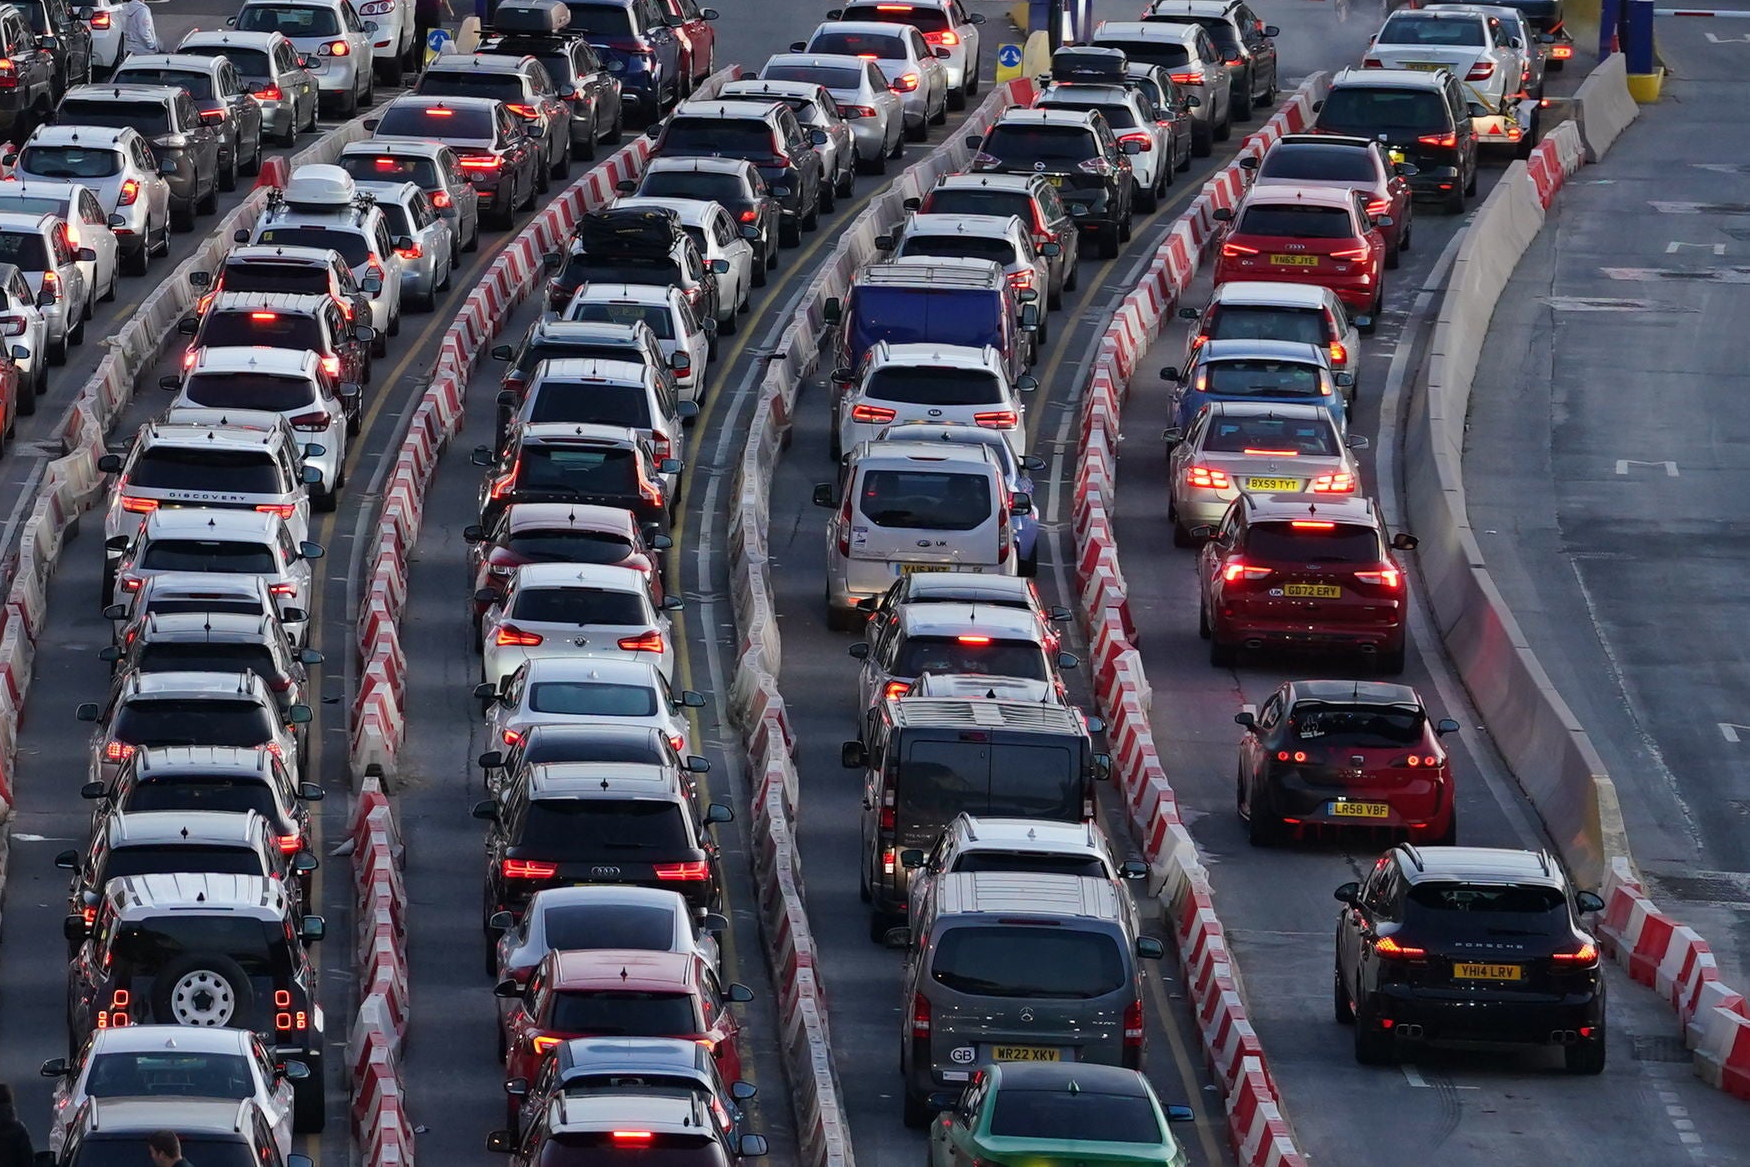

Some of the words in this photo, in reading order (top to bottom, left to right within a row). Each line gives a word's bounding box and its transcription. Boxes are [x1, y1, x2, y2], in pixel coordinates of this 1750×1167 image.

[1252, 479, 1277, 489] BX59
[1278, 480, 1296, 489] TYT
[170, 492, 246, 500] DISCOVERY
[1317, 587, 1337, 596] ERY
[1335, 802, 1363, 814] LR58
[1366, 804, 1387, 815] VBF
[1461, 964, 1488, 977] YH14
[1490, 965, 1514, 978] LRV
[952, 1049, 972, 1060] GB
[997, 1048, 1029, 1060] WR22
[1032, 1049, 1056, 1061] XKV
